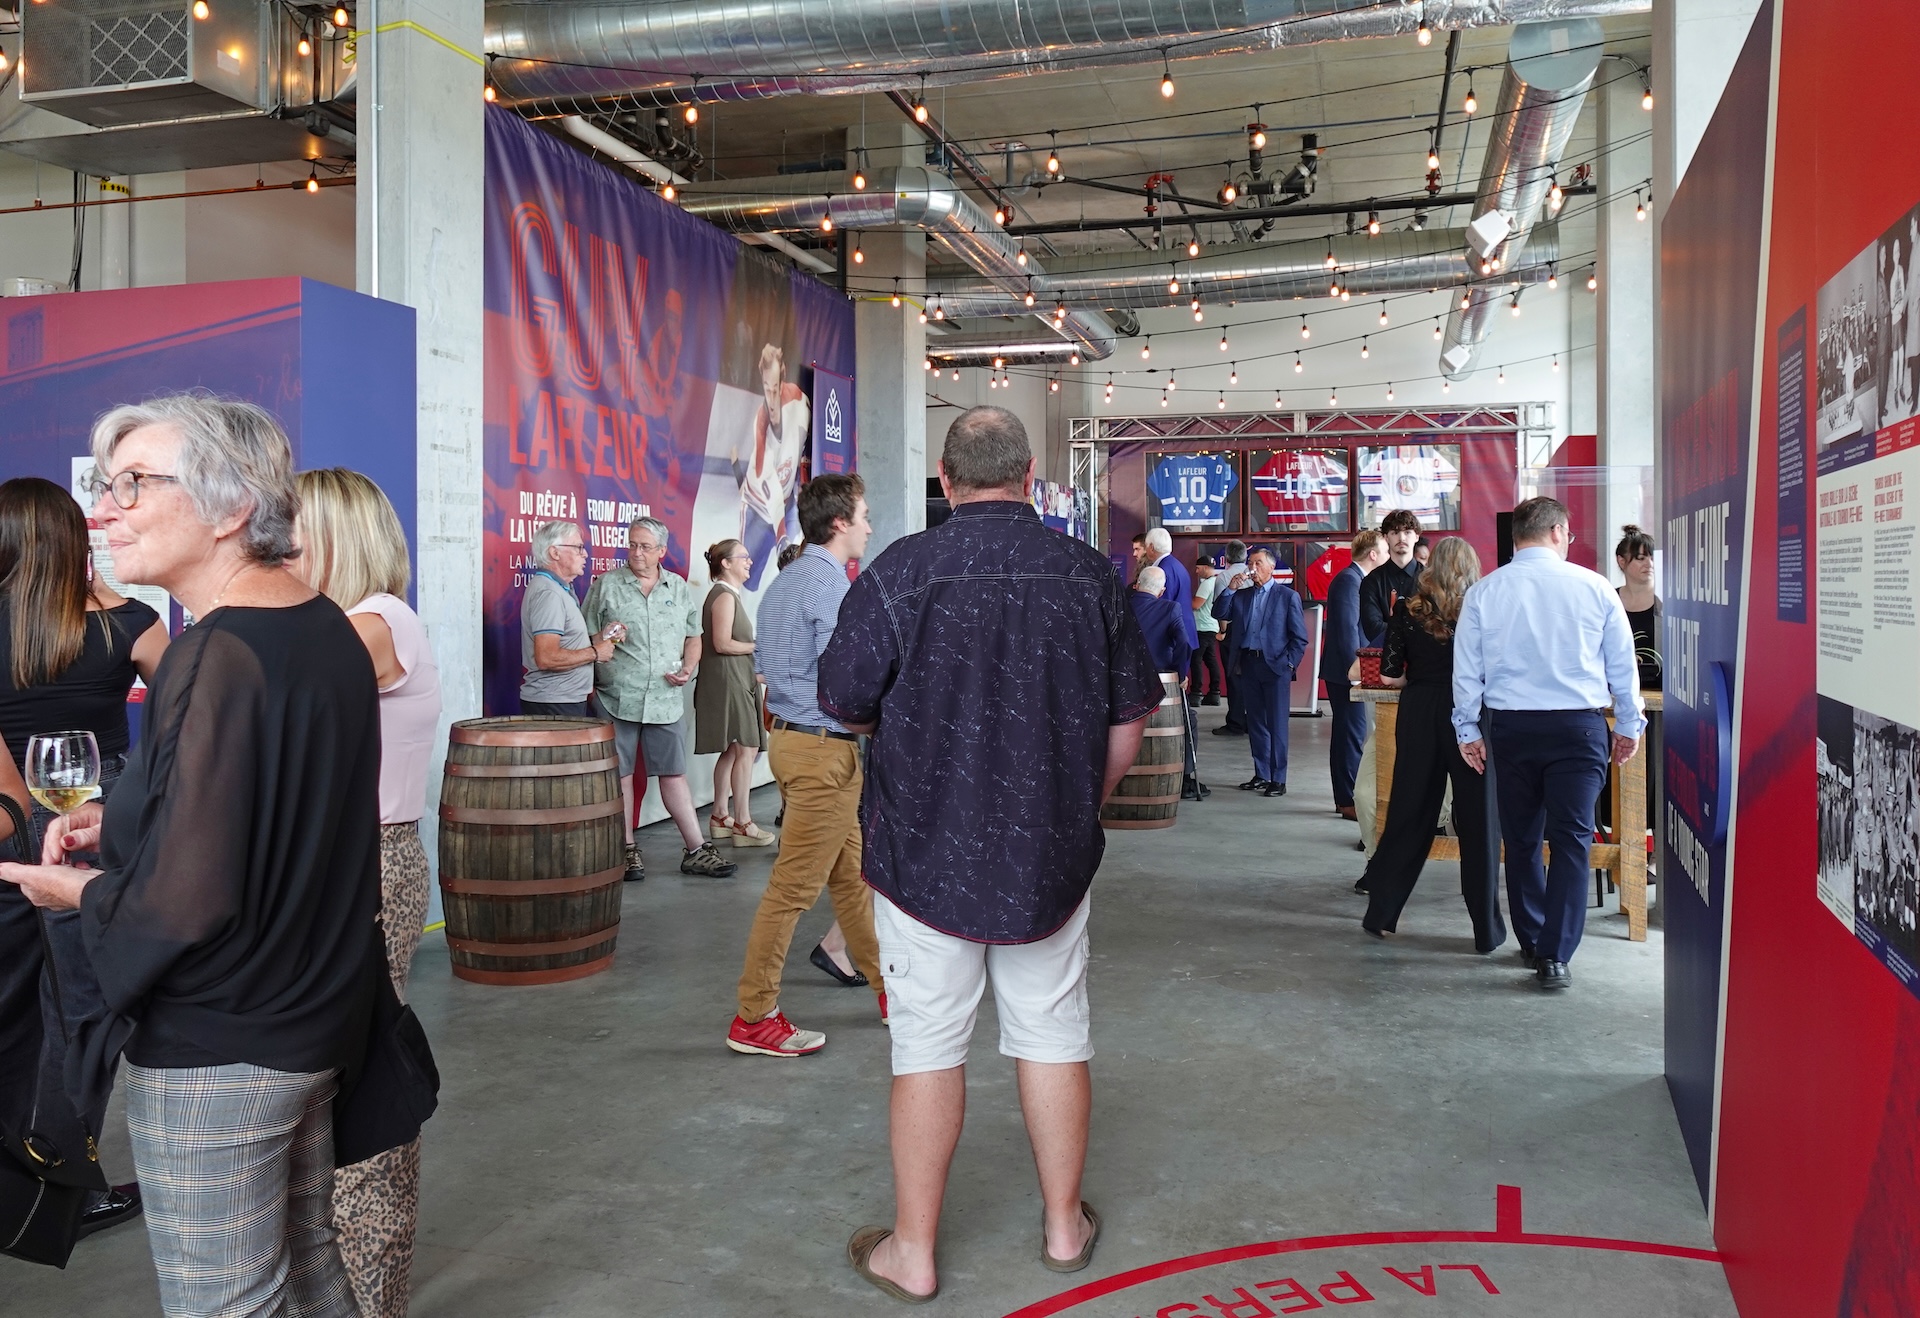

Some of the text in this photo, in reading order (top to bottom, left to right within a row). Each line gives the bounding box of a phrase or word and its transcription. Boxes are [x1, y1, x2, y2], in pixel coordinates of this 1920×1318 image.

[511, 202, 649, 400] GUY
[509, 384, 648, 483] LAFLEUR
[1178, 466, 1208, 476] LAFLEUR
[1178, 476, 1208, 504] 10
[1284, 473, 1312, 500] 10
[519, 489, 577, 519] DU RÊVE À
[586, 498, 615, 522] FROM
[510, 518, 525, 543] LA
[589, 525, 630, 549] TO LEGEN
[509, 554, 522, 569] LA
[590, 557, 606, 571] THE
[1668, 514, 1689, 601] D'UN
[1692, 501, 1730, 606] JEUNE
[1668, 615, 1700, 711] TALENT
[1382, 1264, 1502, 1297] LA
